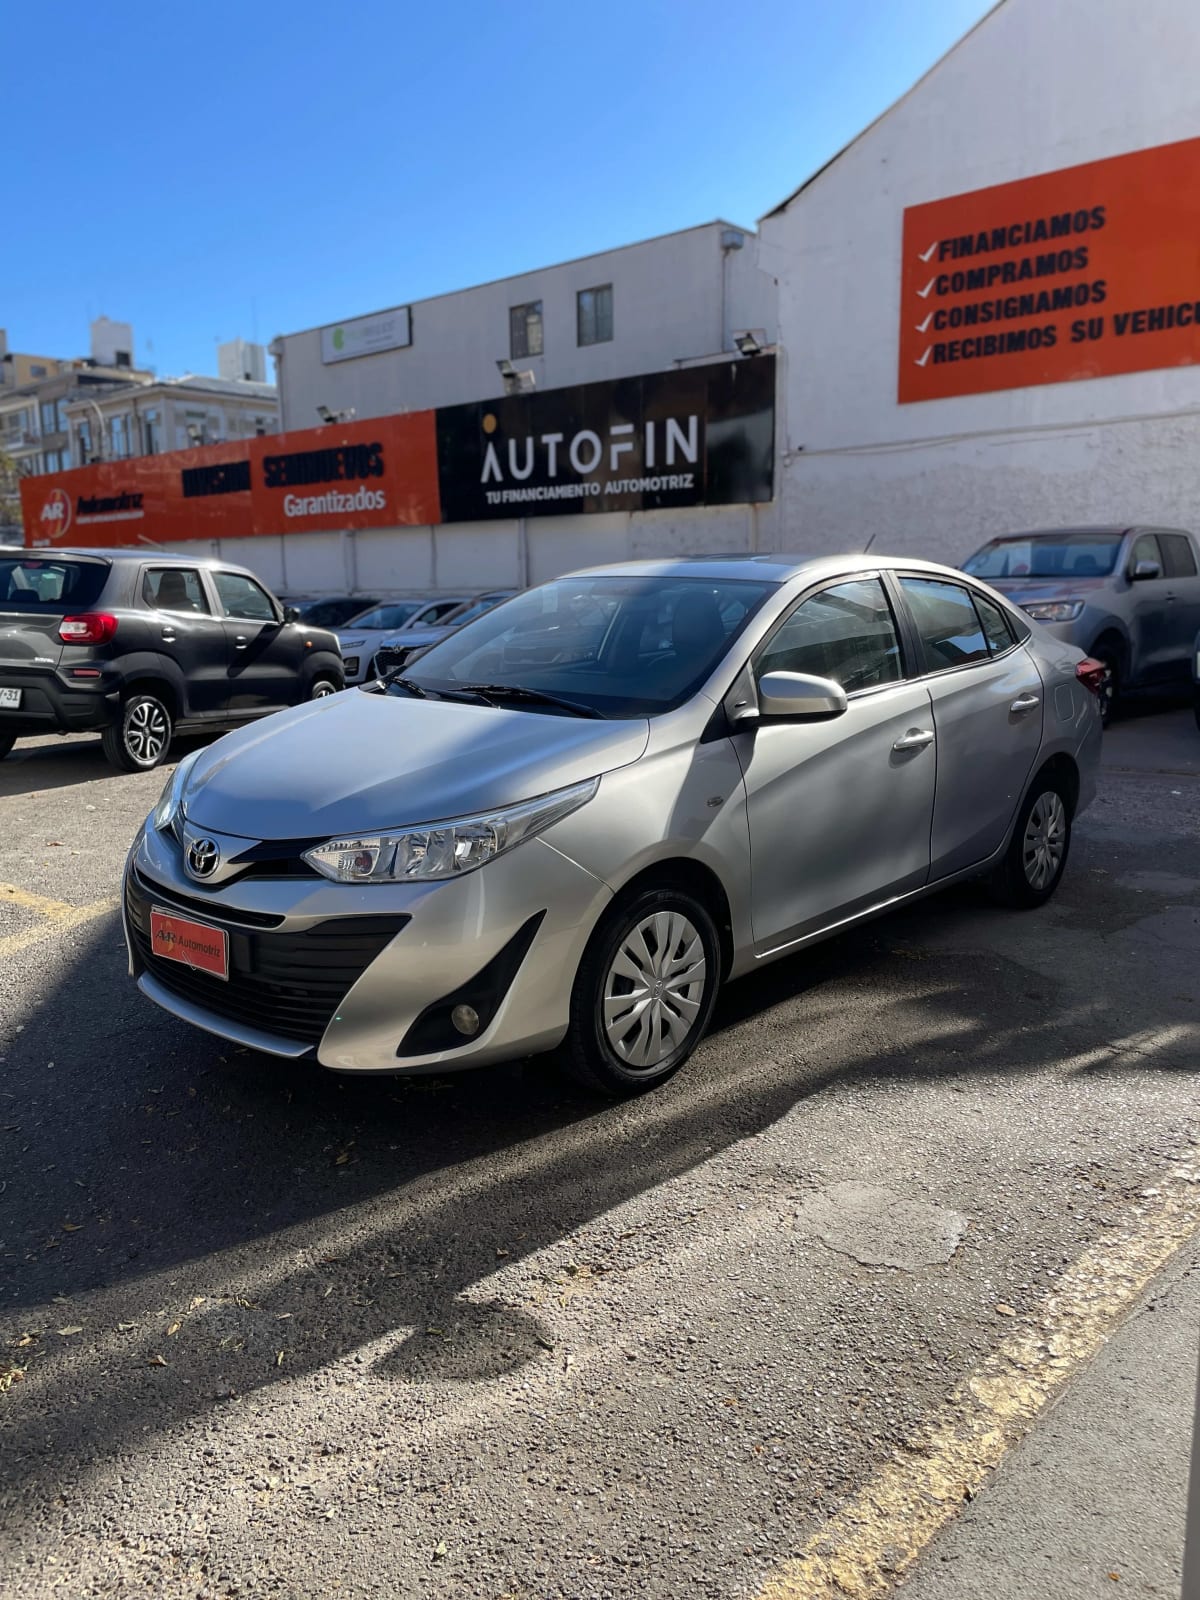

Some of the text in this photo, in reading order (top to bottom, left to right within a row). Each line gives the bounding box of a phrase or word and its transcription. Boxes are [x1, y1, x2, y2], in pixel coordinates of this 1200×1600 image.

[938, 206, 1106, 262] FINANCIAMOS
[935, 247, 1088, 296] COMPRAMOS
[933, 280, 1107, 330] CONSIGNAMOS
[933, 326, 1057, 364] RECIBIMOS
[1070, 317, 1104, 343] SU
[480, 414, 698, 484] AUTOFIN
[284, 485, 386, 517] Garantizados
[486, 473, 694, 504] TU FINANCIAMIENTO AUTOMOTRIZ
[178, 935, 220, 957] Automotriz
